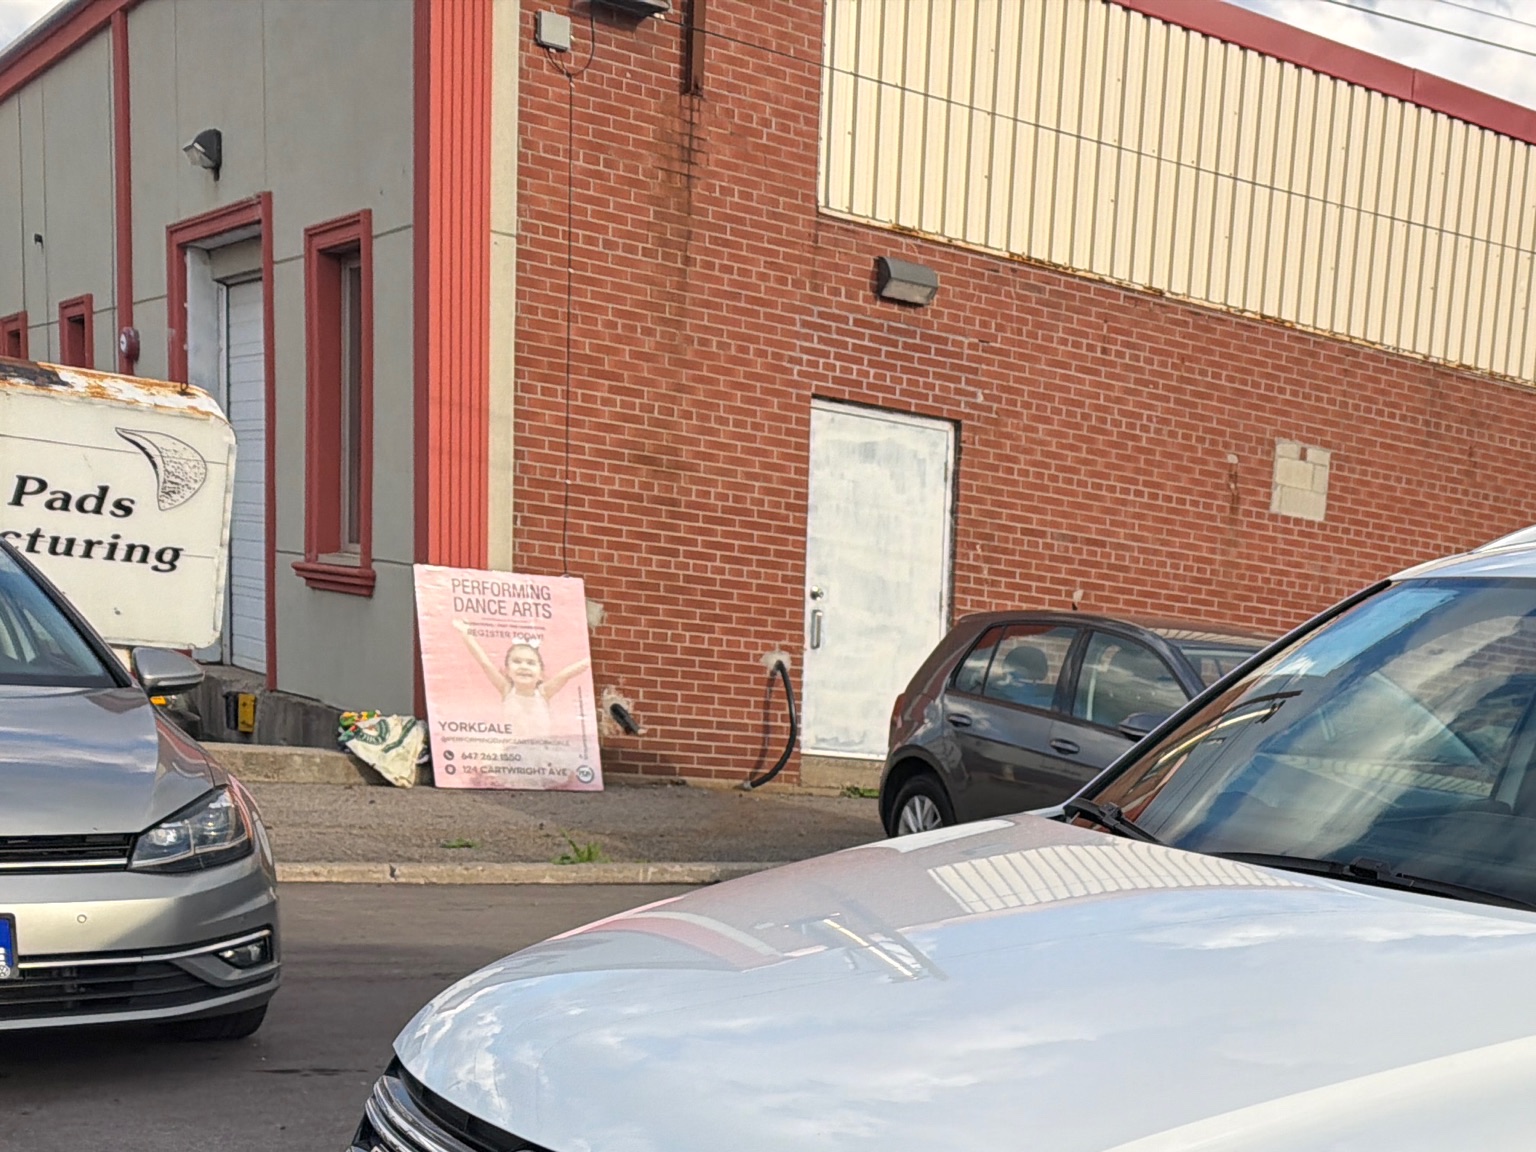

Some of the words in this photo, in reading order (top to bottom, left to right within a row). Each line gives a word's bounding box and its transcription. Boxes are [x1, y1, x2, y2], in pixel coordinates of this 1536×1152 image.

[7, 474, 136, 518] Pads
[451, 578, 551, 601] PERFORMING
[453, 597, 507, 616] DANCE
[512, 601, 552, 619] ARTS
[438, 721, 512, 734] YORKDALE
[461, 752, 479, 760] 647
[548, 768, 568, 777] AVE
